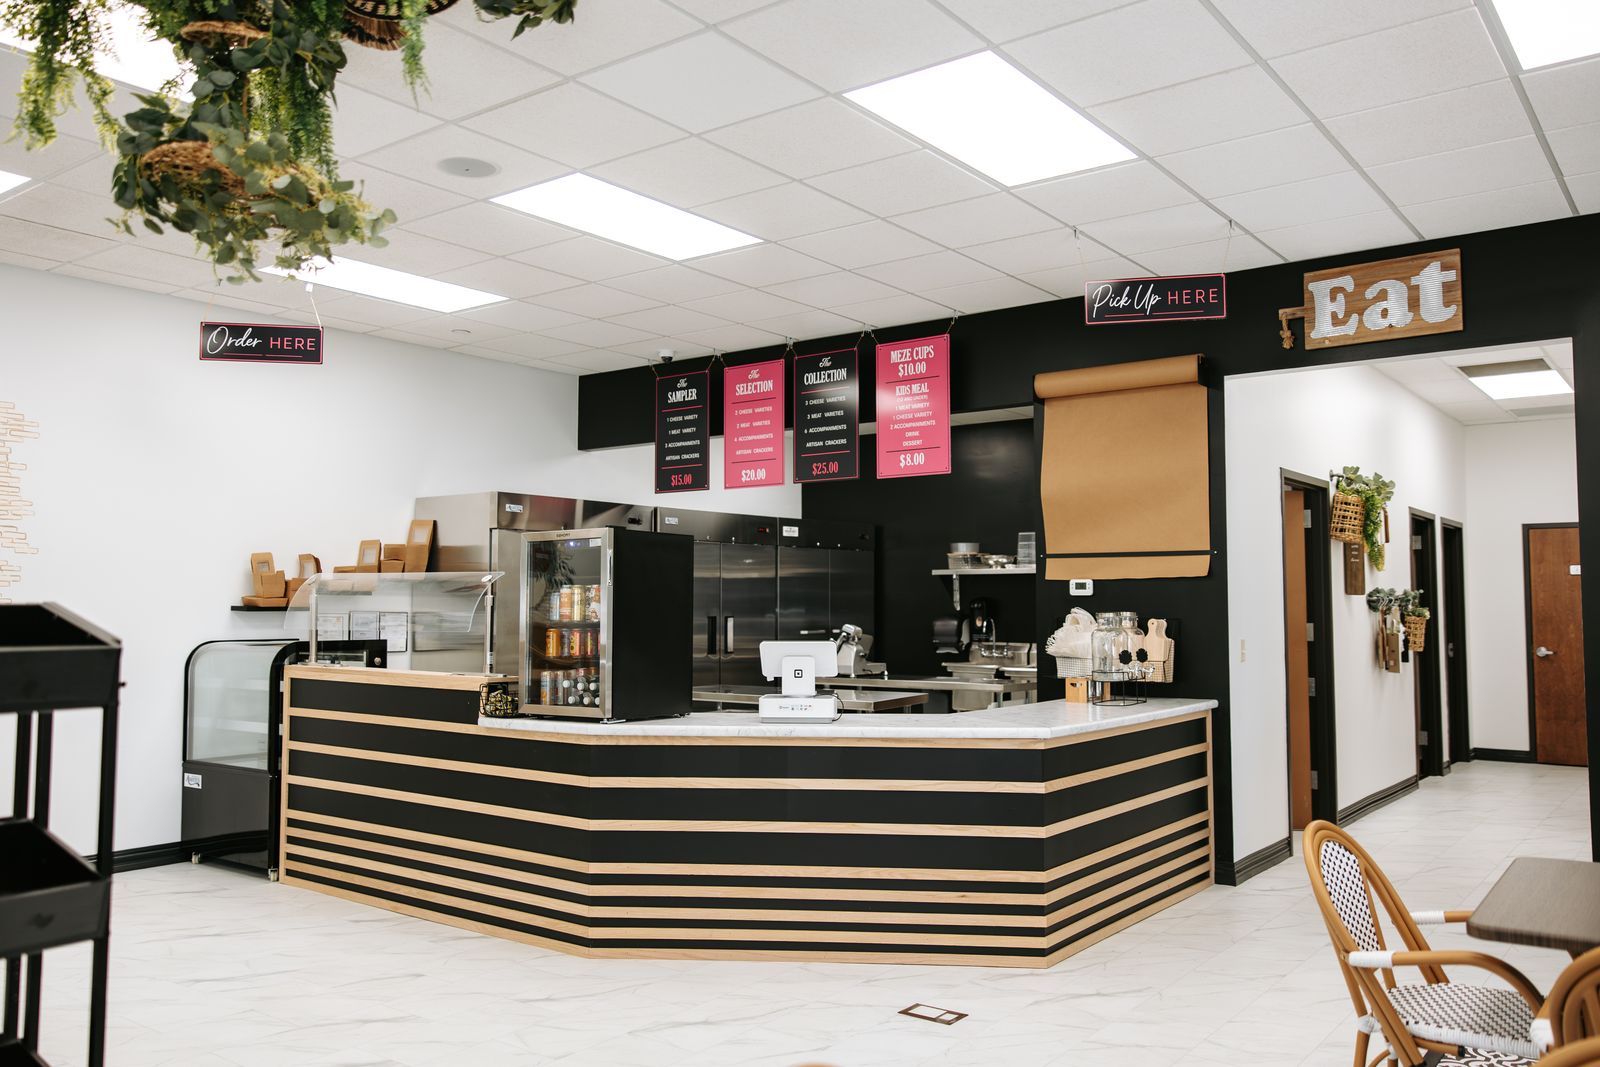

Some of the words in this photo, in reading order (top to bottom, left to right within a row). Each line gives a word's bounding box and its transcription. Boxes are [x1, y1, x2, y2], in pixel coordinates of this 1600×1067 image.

[1092, 284, 1132, 318] Pick
[1134, 283, 1162, 315] Up
[1167, 288, 1219, 305] HERE
[1308, 261, 1457, 339] Eat
[206, 325, 263, 354] Order
[269, 336, 316, 351] HERE
[890, 348, 912, 364] MEZE
[913, 344, 934, 360] CUPS
[819, 356, 832, 368] The
[898, 361, 926, 378] $10.00
[748, 368, 760, 380] The
[804, 368, 848, 386] COLLECTION
[677, 377, 688, 388] The
[736, 380, 774, 396] SELECTION
[896, 384, 911, 396] KIDS
[911, 382, 930, 394] MEAL
[667, 388, 697, 403] SAMPLER
[808, 424, 848, 433] ACCOMPANIMENTS
[894, 420, 936, 430] ACCOMPANIMENTS
[668, 440, 701, 448] ACCOMPANIMENTS
[900, 452, 925, 469] $8.00
[742, 468, 766, 483] $20.00
[812, 461, 838, 476] $25.00
[671, 474, 692, 487] $15.00
